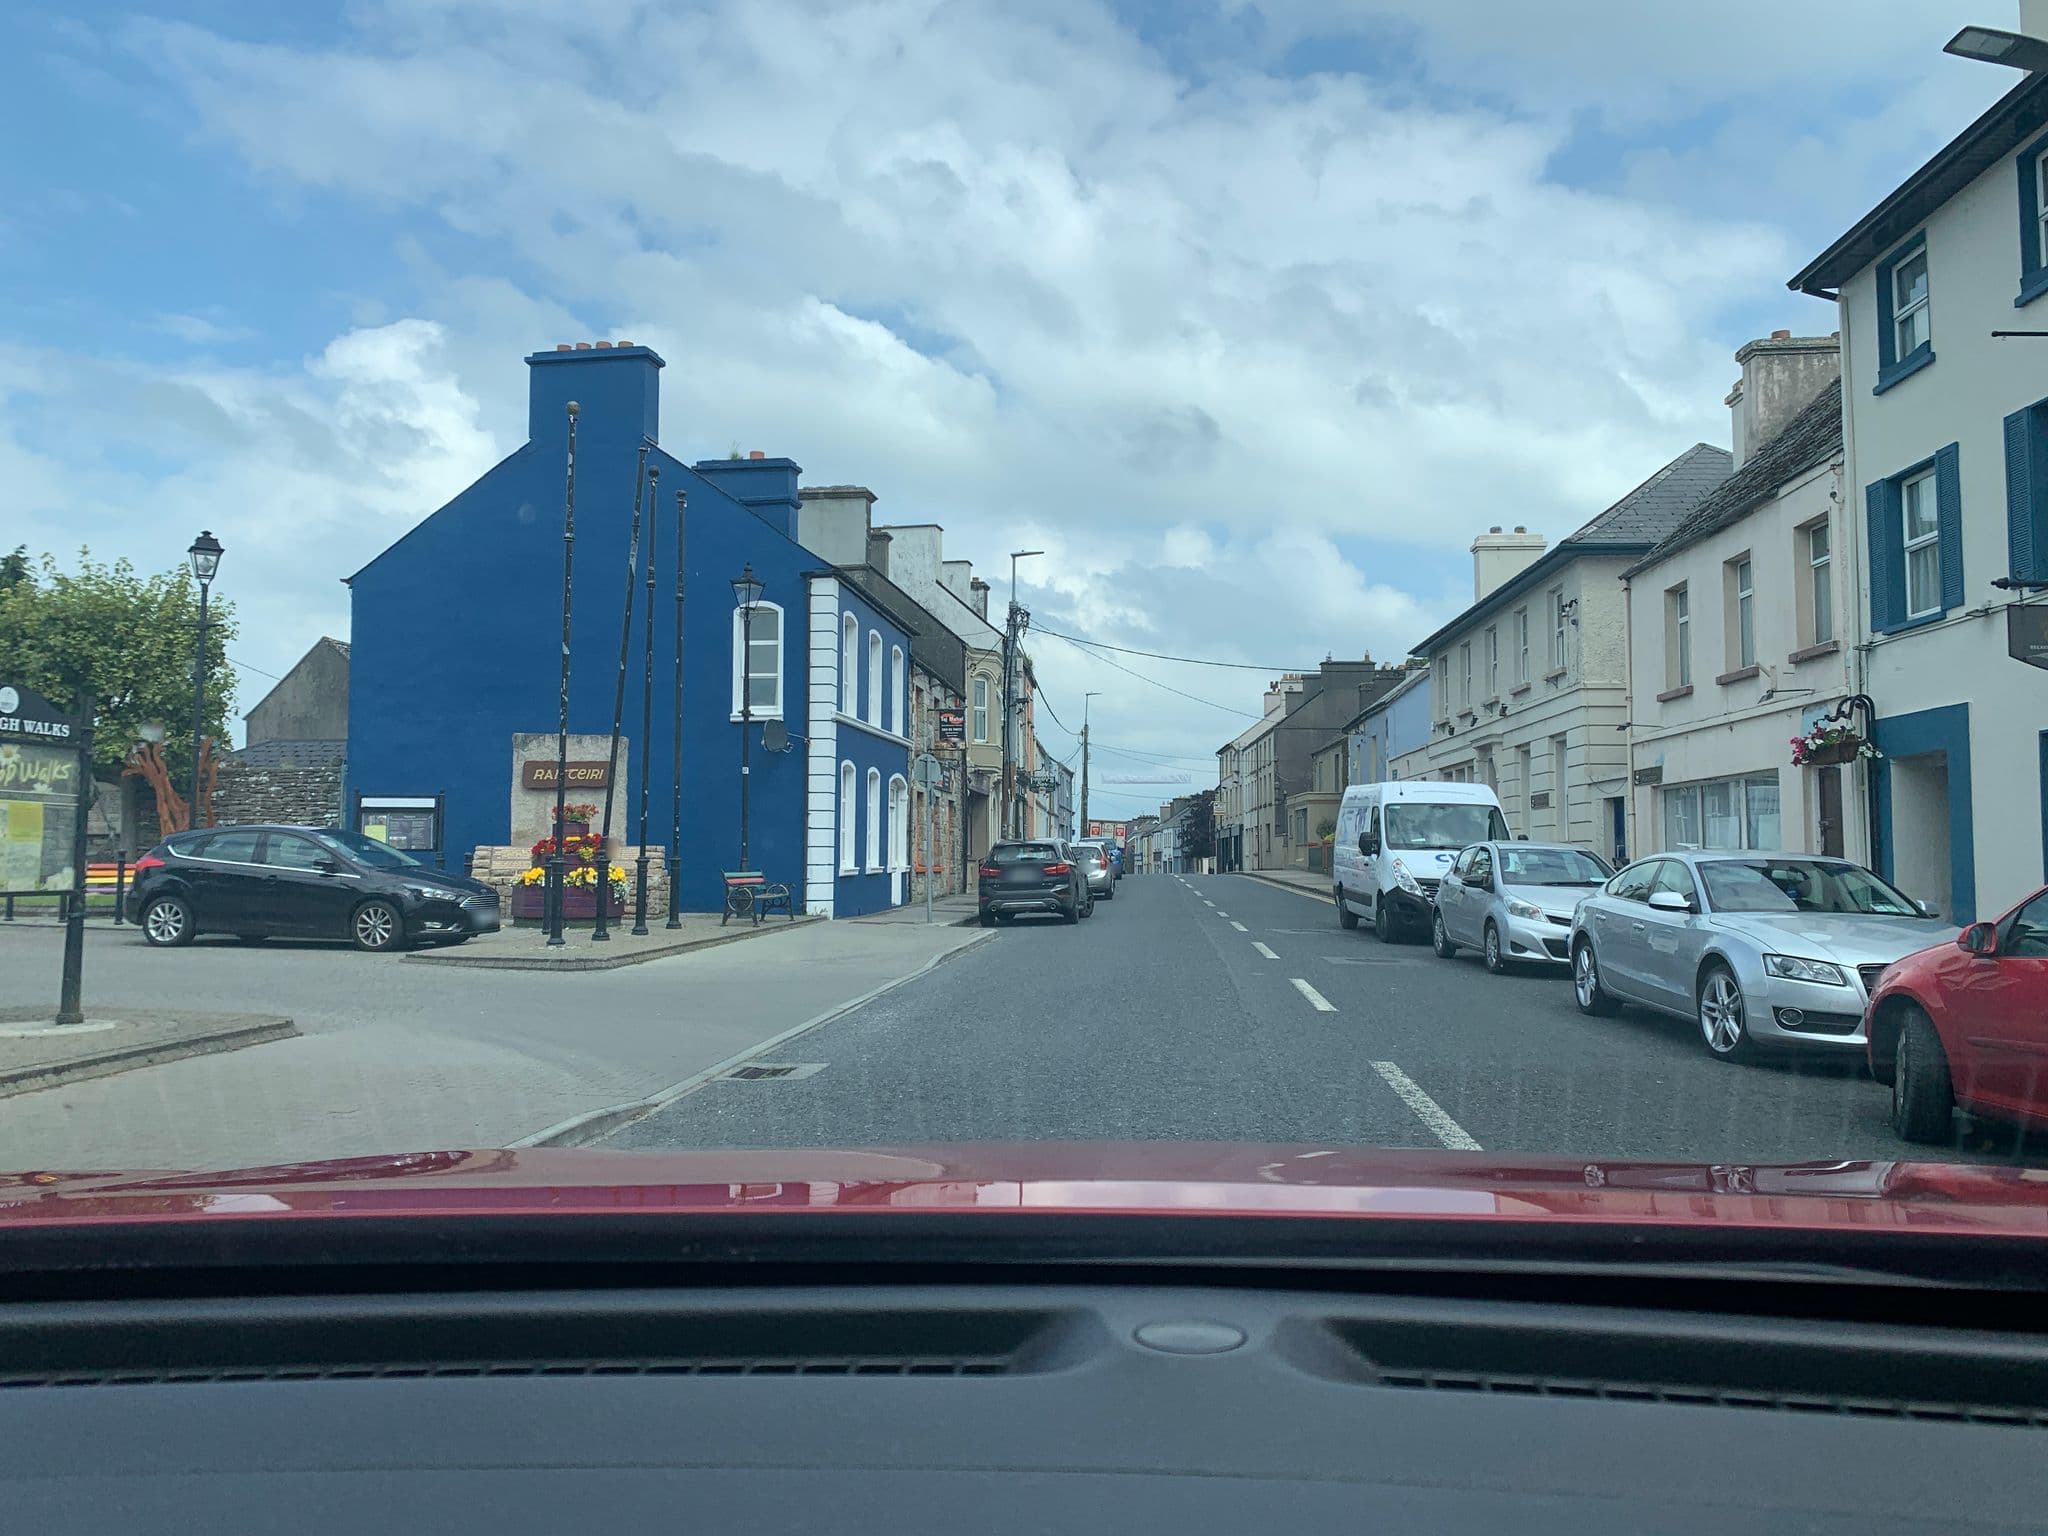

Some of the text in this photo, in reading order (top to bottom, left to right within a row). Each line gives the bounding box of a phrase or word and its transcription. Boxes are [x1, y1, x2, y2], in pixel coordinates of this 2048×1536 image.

[23, 719, 70, 737] WALKS
[20, 760, 72, 784] Walks
[533, 769, 604, 780] RAITEIRI
